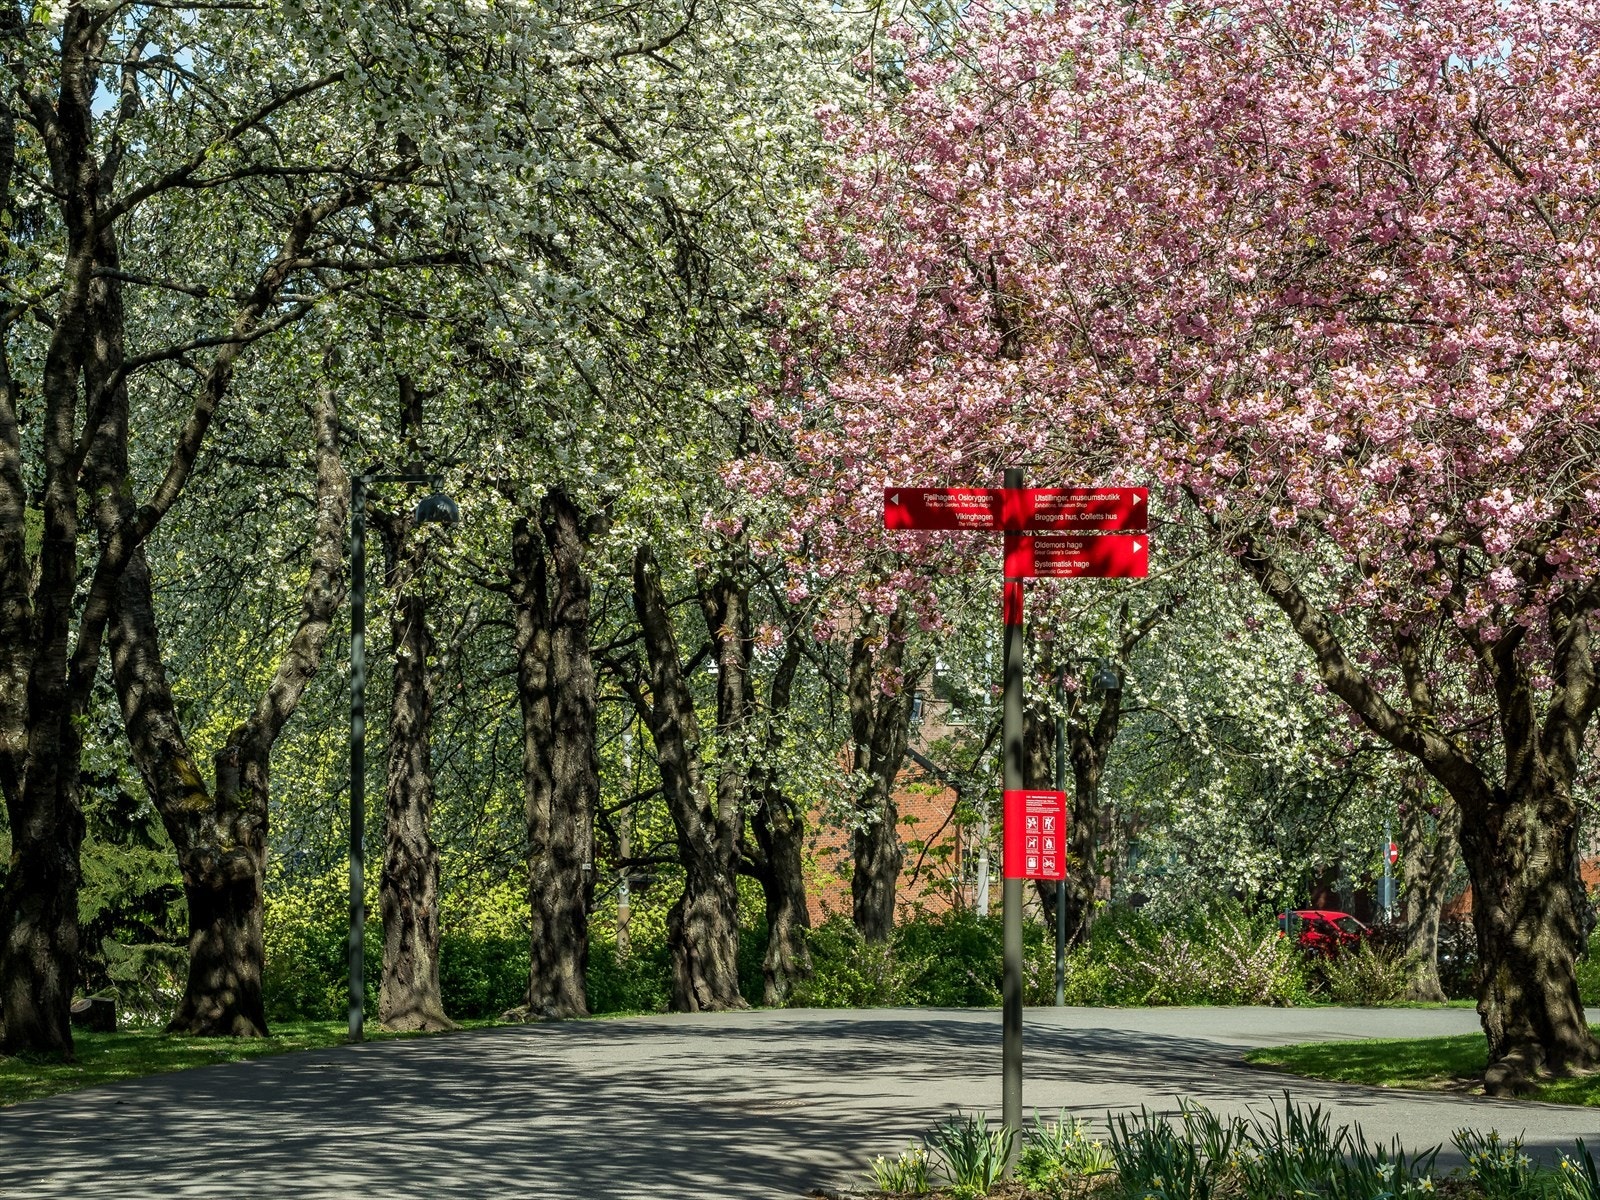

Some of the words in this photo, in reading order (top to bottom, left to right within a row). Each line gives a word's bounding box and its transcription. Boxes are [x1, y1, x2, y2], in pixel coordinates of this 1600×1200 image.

[924, 494, 957, 502] Fjellhagen,
[955, 513, 994, 522] Vikinghagen
[1067, 541, 1082, 549] hage
[1035, 561, 1072, 569] Systematisk
